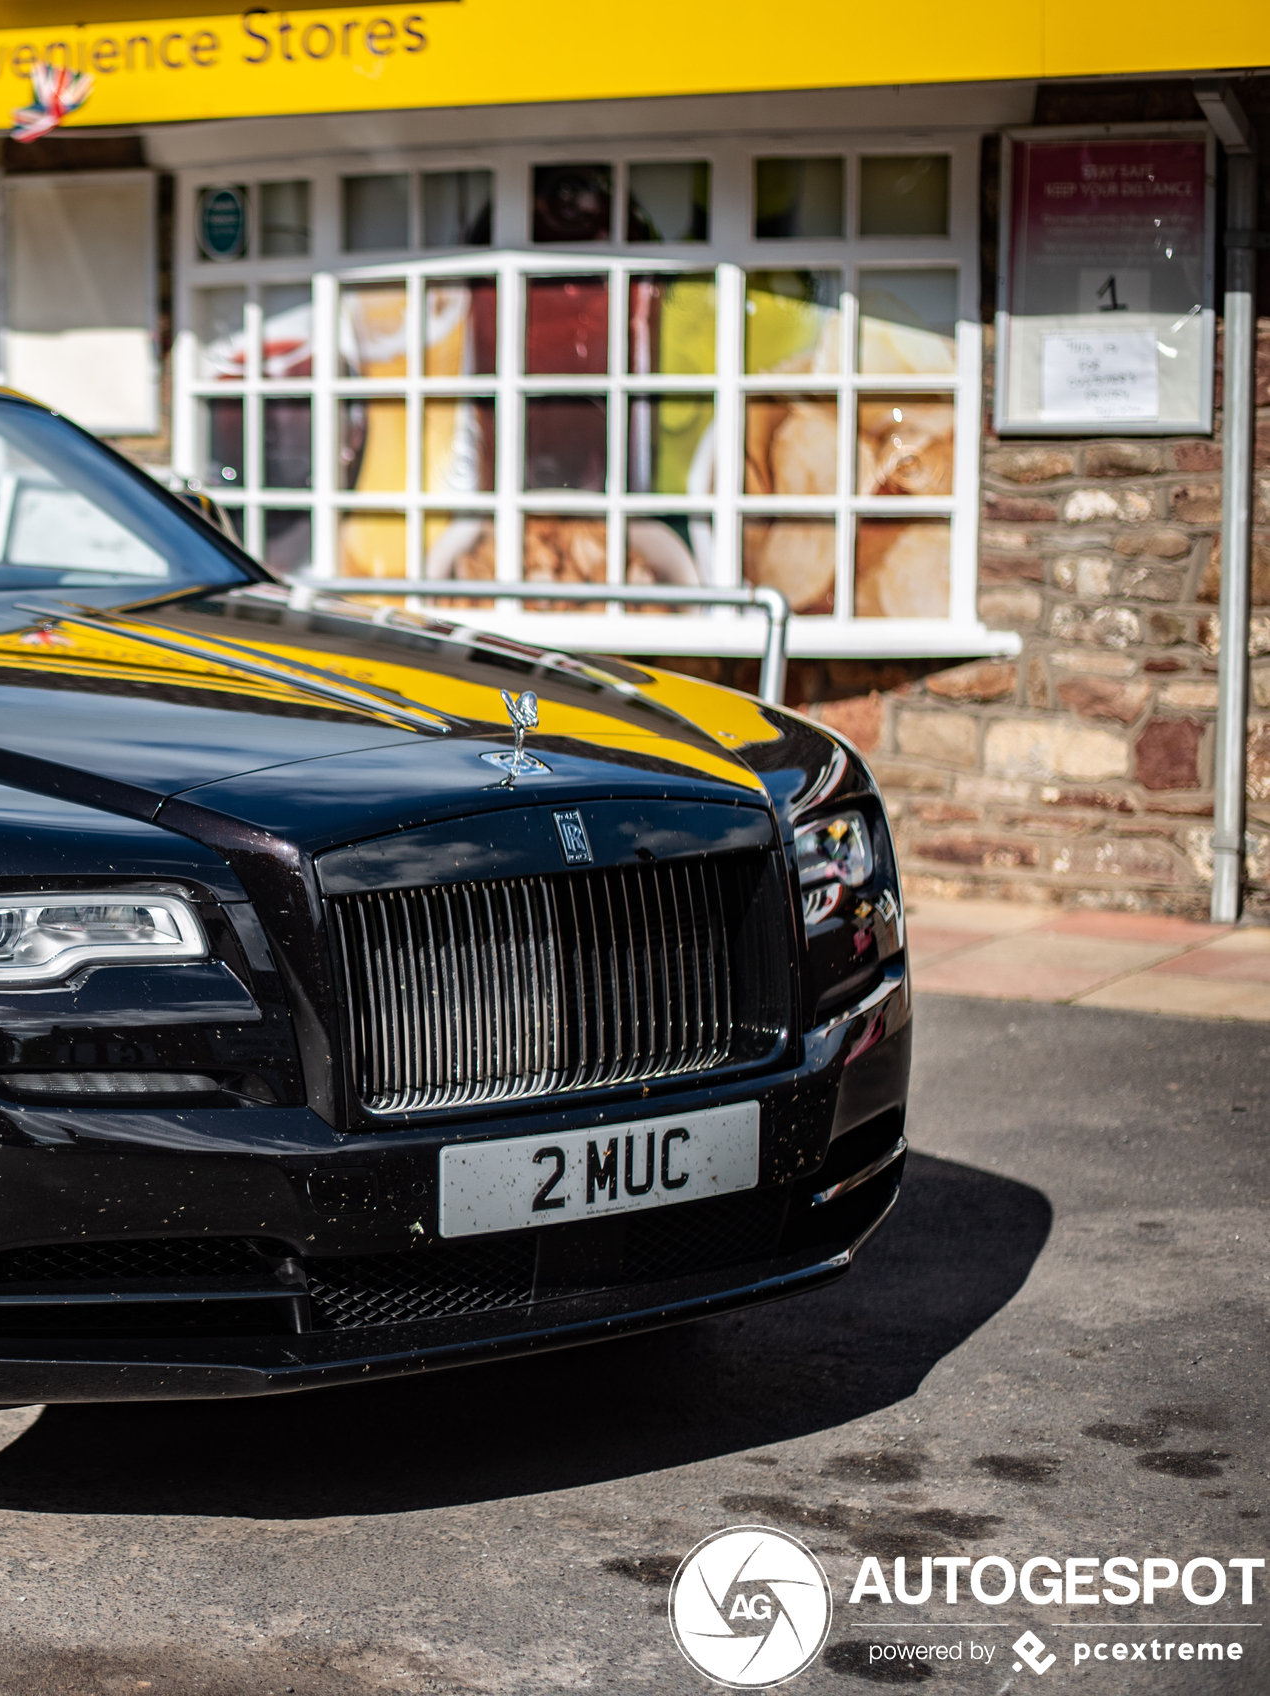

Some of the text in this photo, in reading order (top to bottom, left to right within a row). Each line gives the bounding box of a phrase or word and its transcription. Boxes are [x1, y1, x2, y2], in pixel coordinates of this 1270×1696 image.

[241, 8, 428, 64] Stores
[1044, 181, 1192, 198] KEEP YOUR DISTANCE
[1081, 163, 1155, 180] STAY SAFE
[1096, 274, 1127, 310] 1
[531, 1127, 691, 1213] 2 MUC
